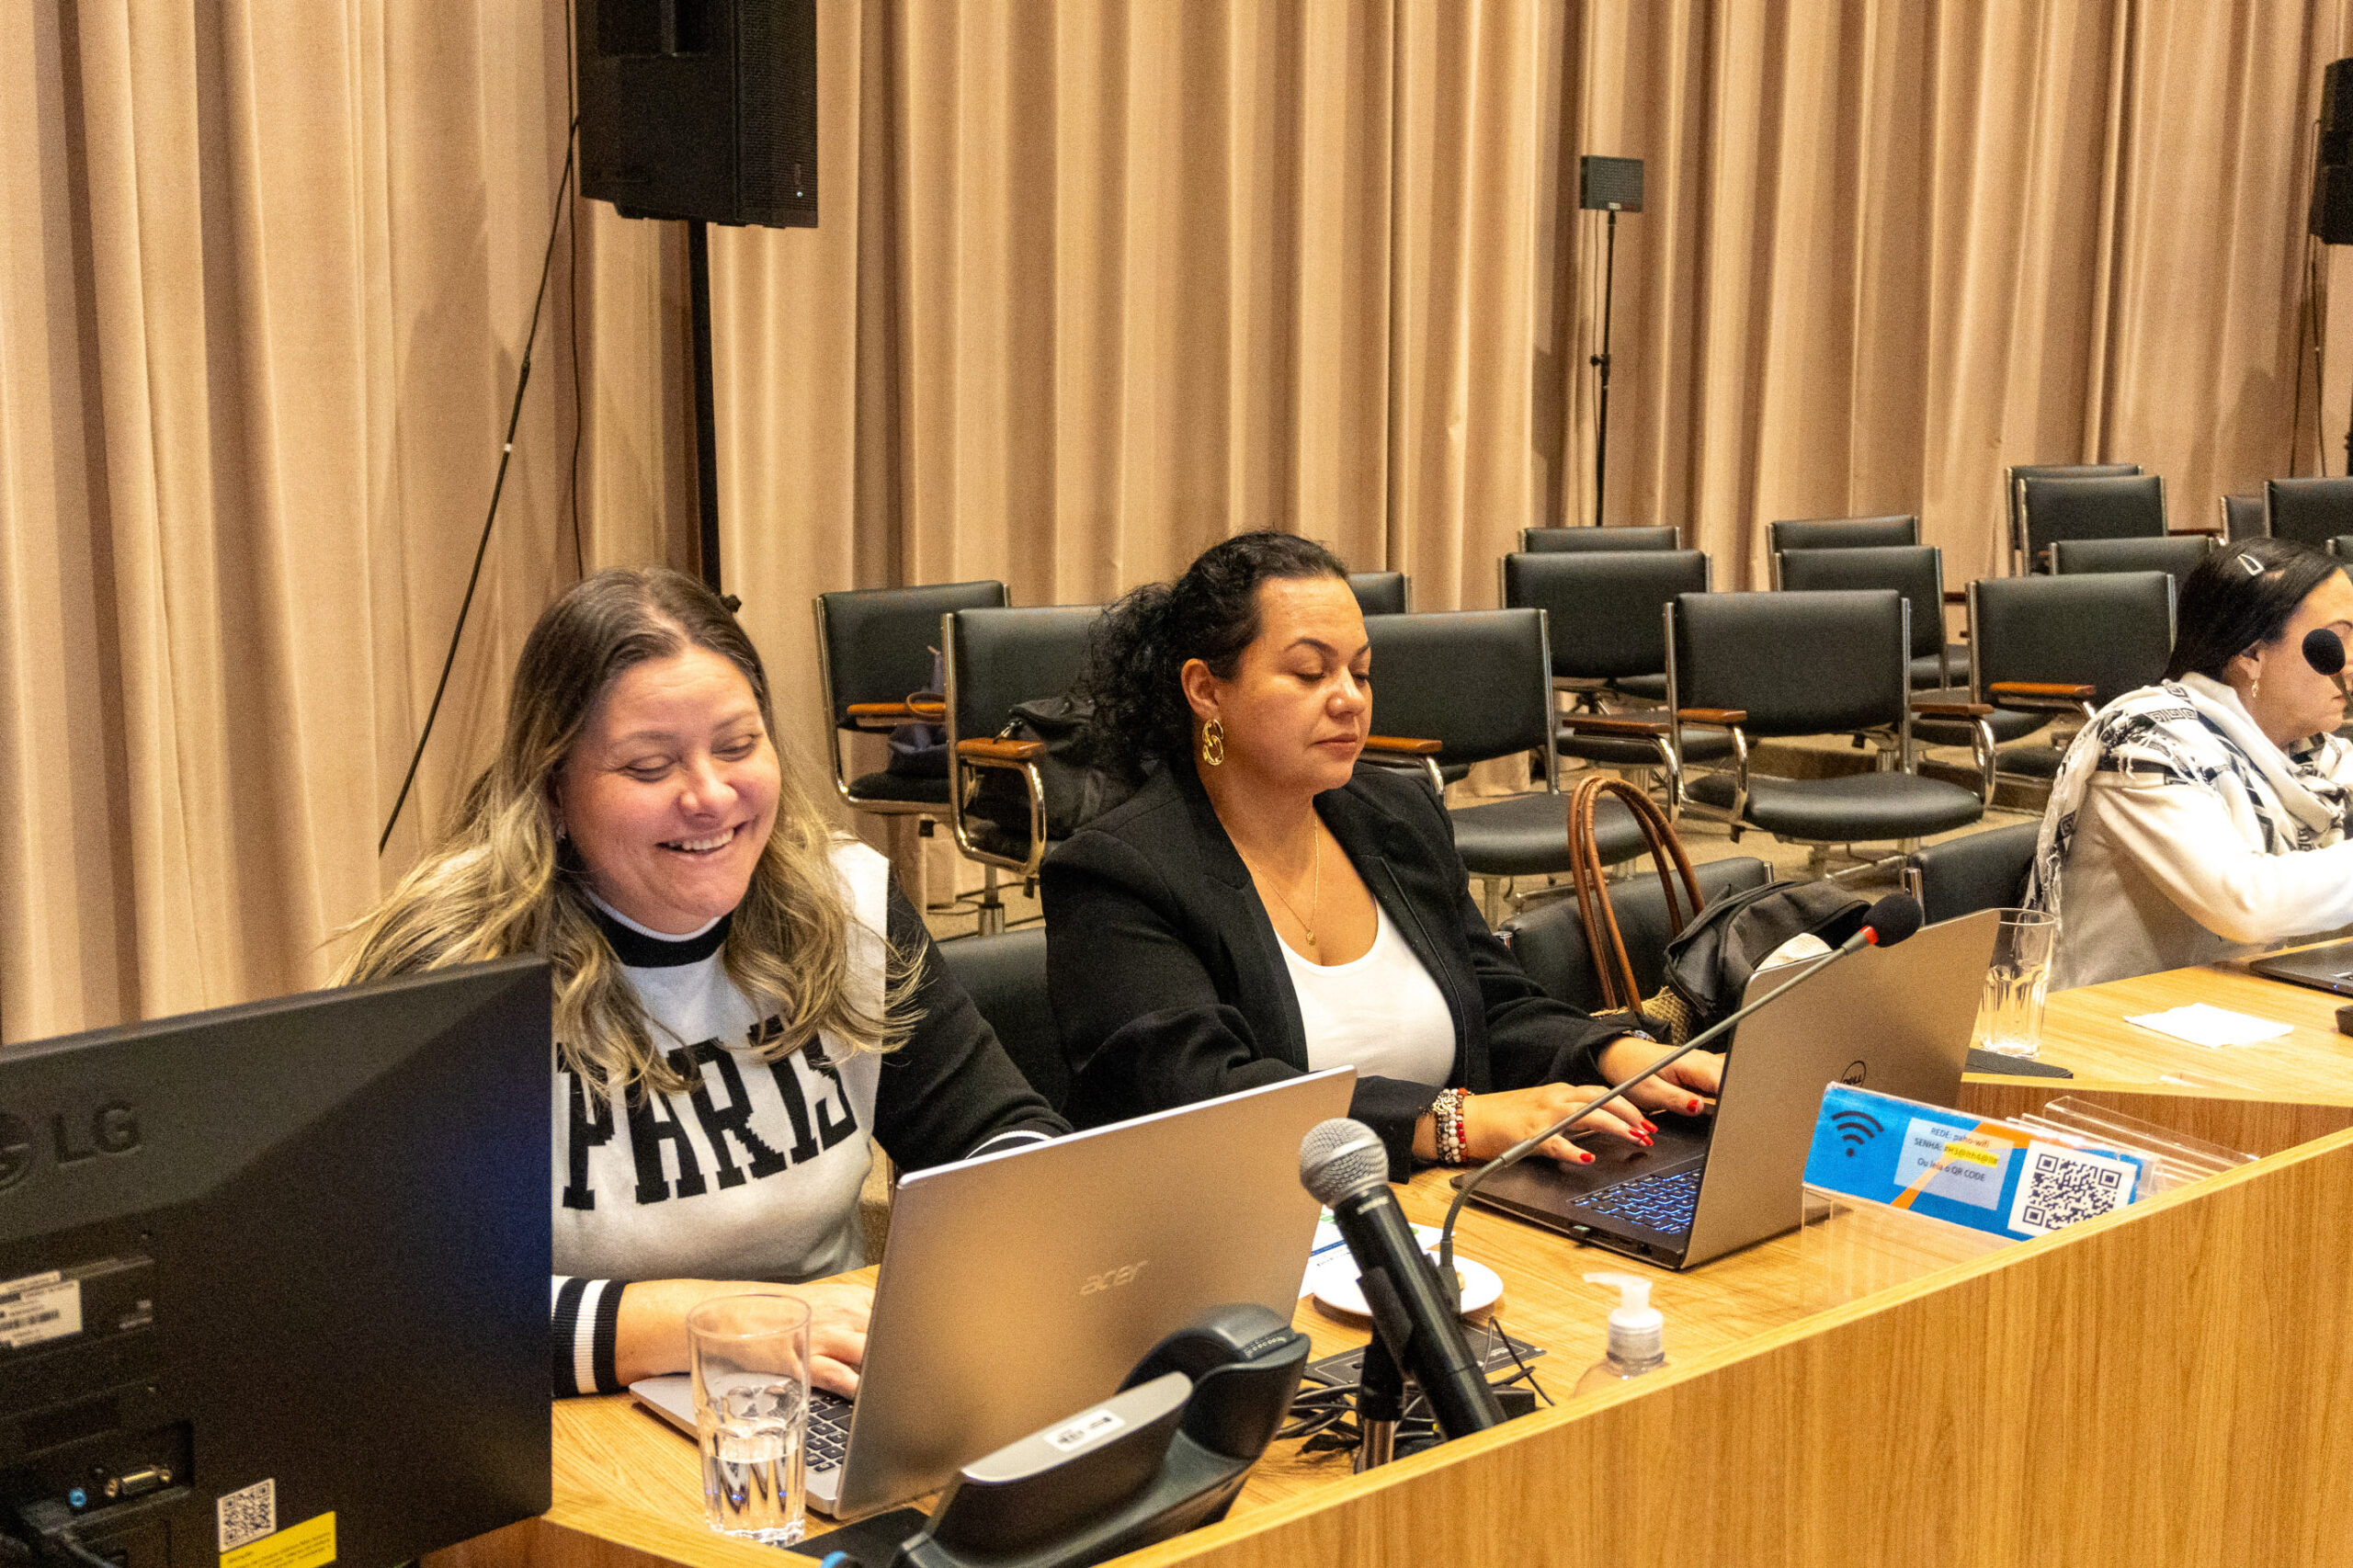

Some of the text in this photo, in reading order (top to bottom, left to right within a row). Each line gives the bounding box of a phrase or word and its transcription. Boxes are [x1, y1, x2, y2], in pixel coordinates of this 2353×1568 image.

[52, 1102, 141, 1165] LG
[1914, 1138, 1942, 1152] SENHA:
[1916, 1157, 1929, 1167] Ou
[1950, 1165, 1963, 1176] QR
[1964, 1169, 1985, 1181] CODE
[1079, 1260, 1149, 1296] acer
